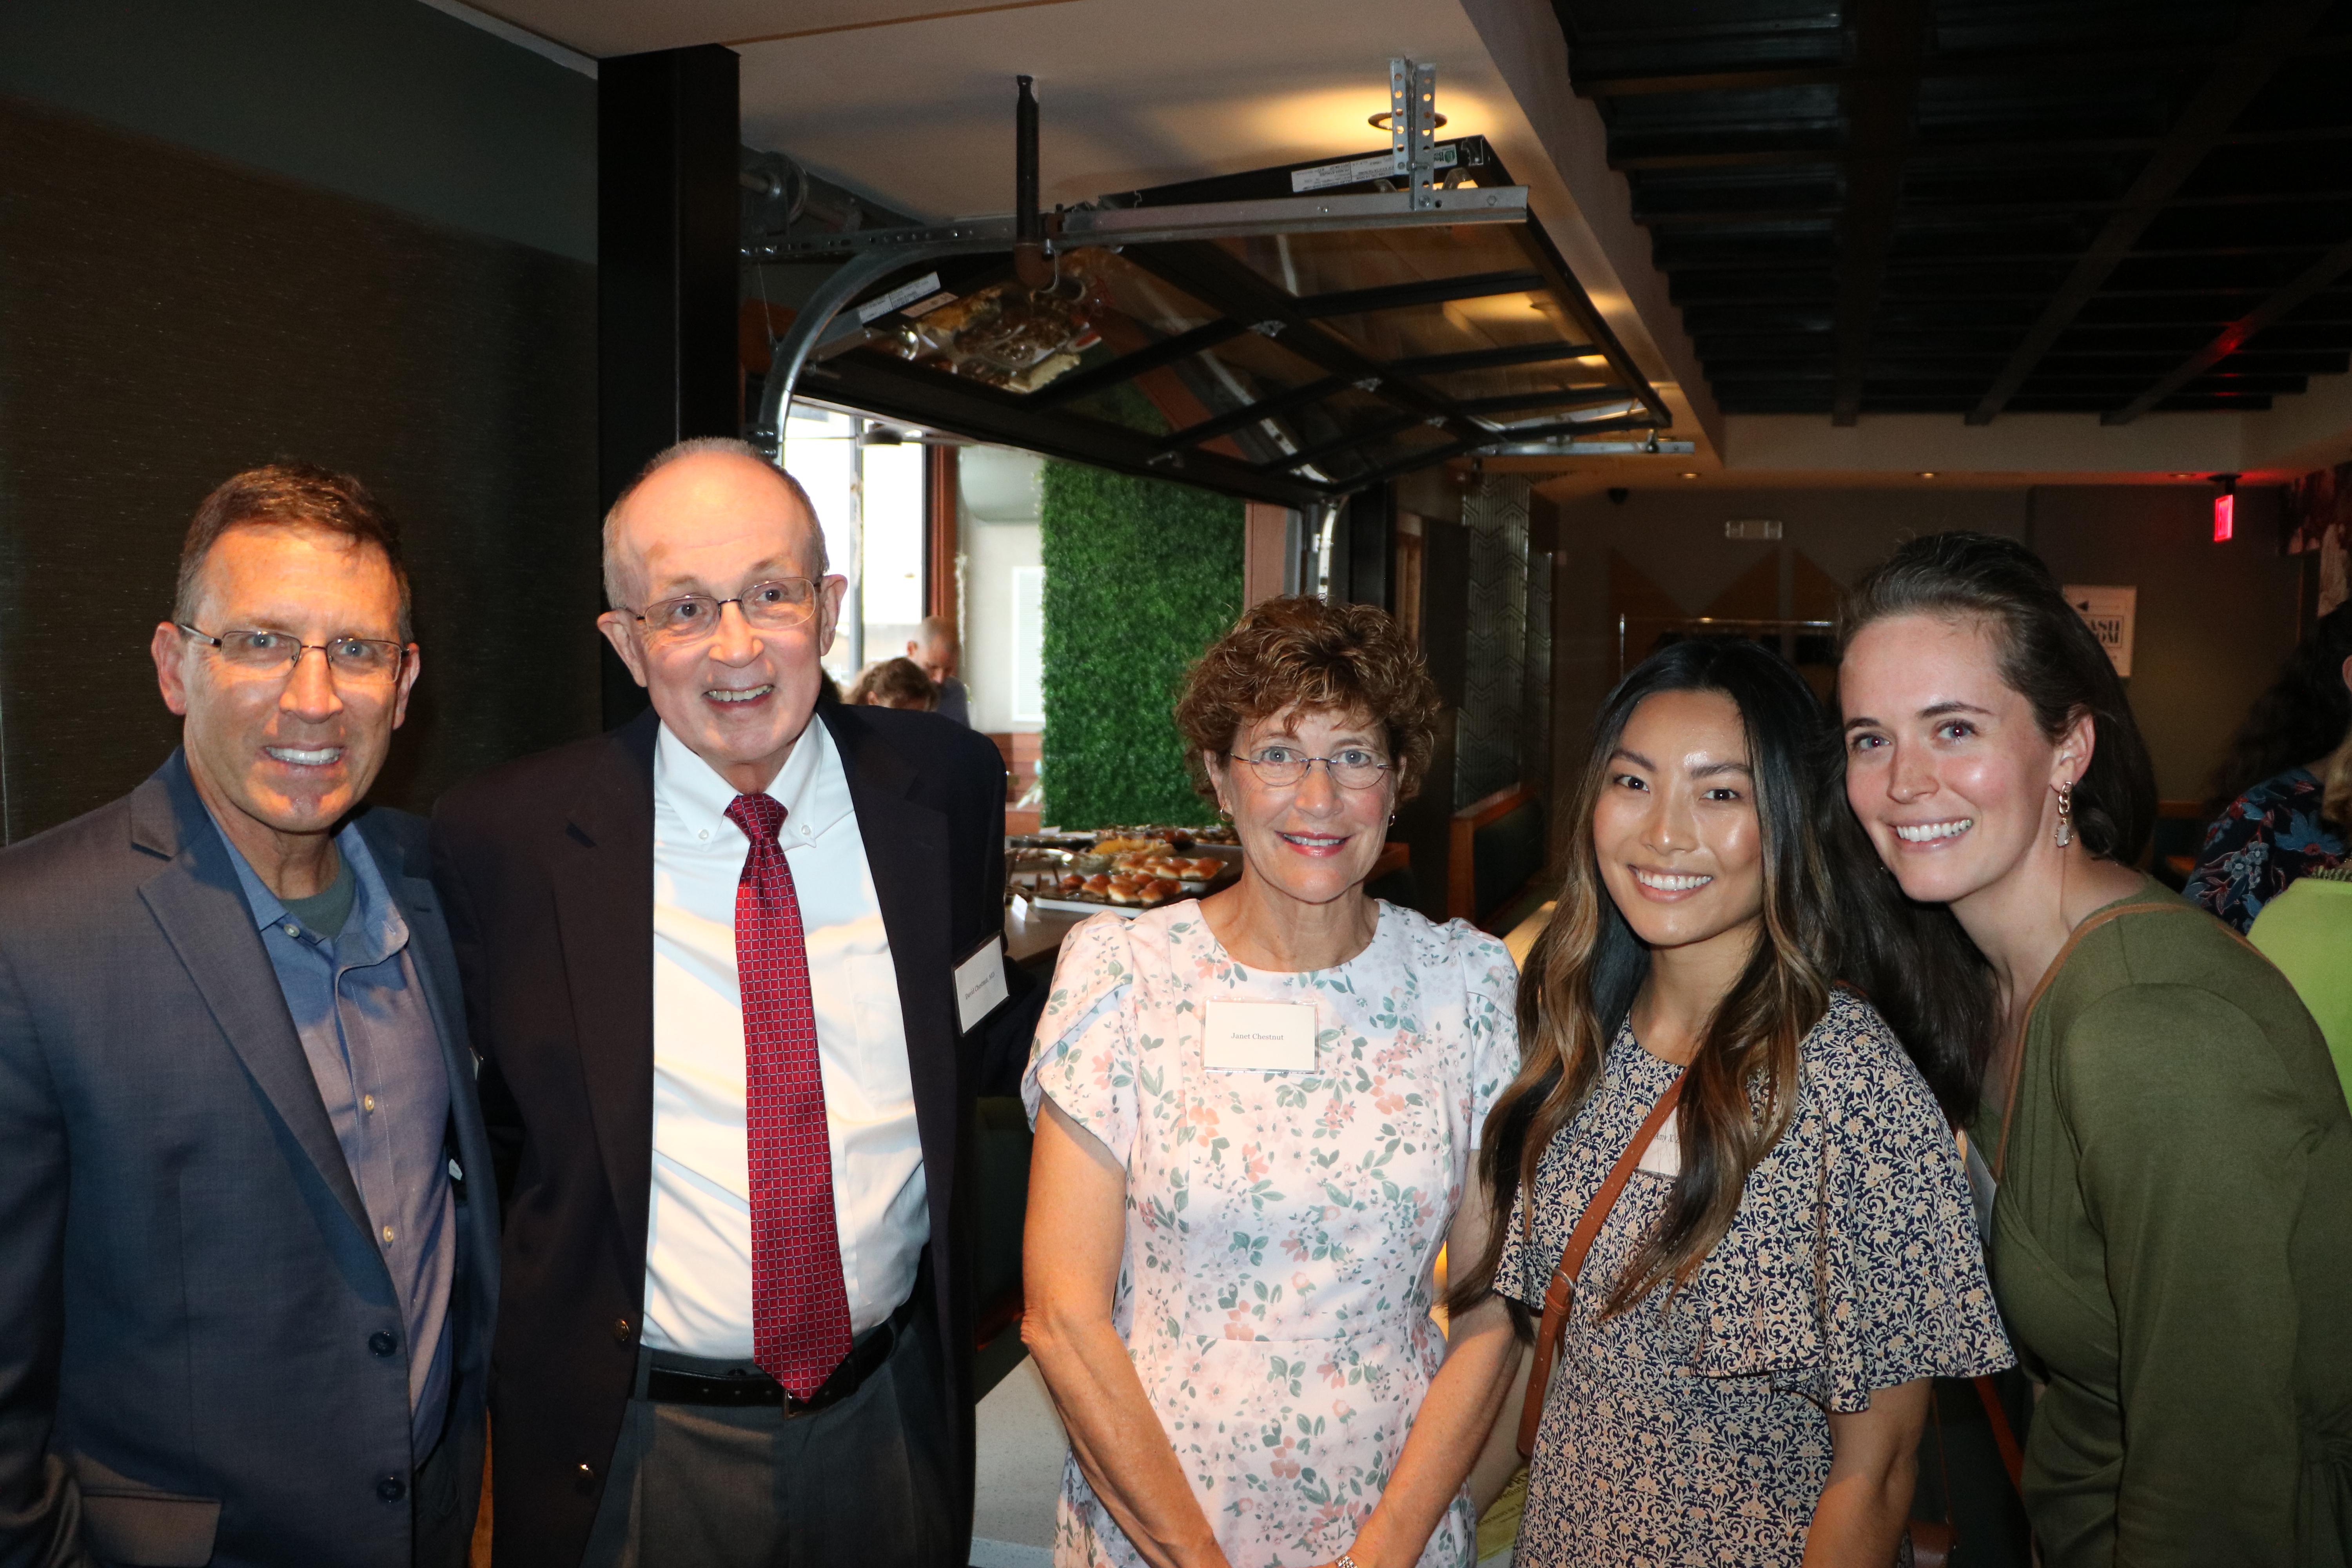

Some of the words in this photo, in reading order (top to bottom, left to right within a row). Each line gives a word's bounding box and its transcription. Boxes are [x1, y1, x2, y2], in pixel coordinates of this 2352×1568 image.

[2088, 620, 2120, 631] ASH
[965, 988, 975, 1000] David
[1654, 1132, 1668, 1143] Amy
